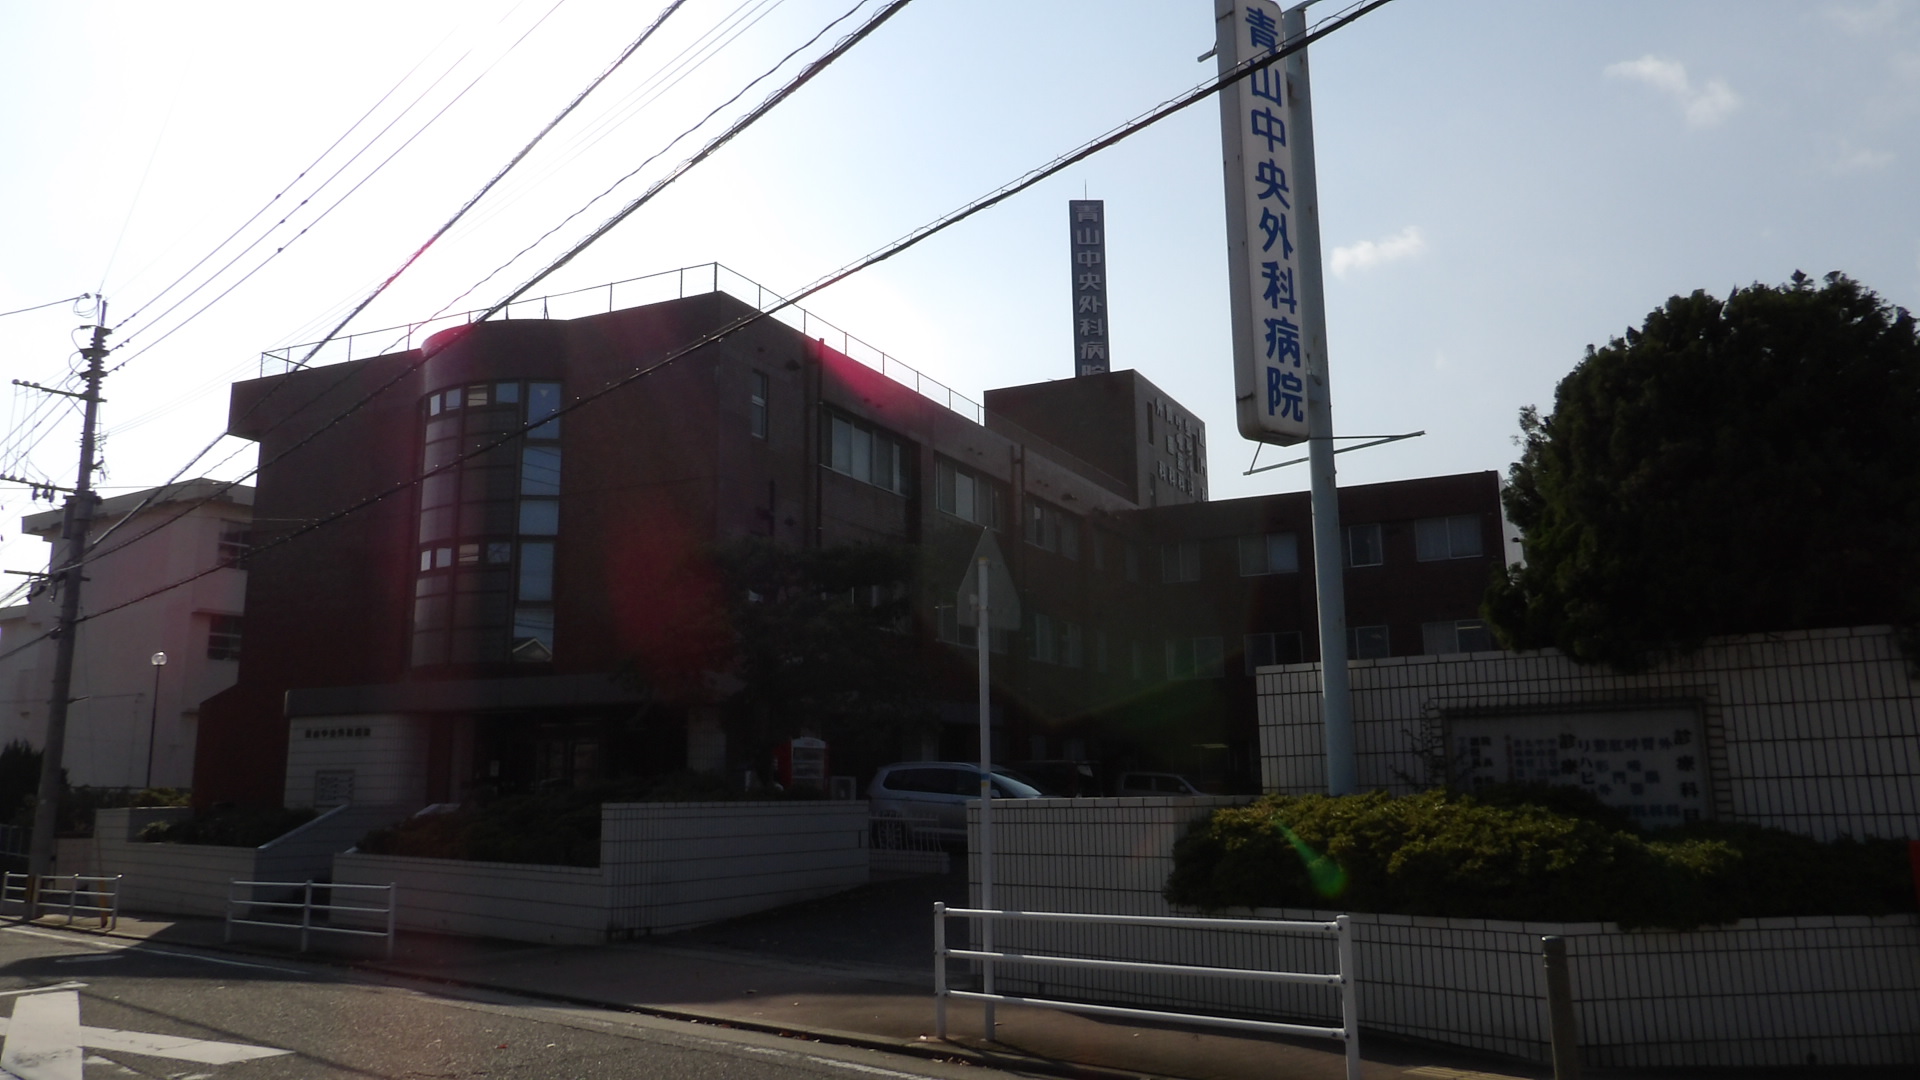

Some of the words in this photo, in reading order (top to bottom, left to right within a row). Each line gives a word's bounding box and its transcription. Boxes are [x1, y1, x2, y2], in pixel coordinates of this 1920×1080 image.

[1246, 7, 1304, 422] 青山中央外科病院
[1578, 739, 1595, 791] リハビ
